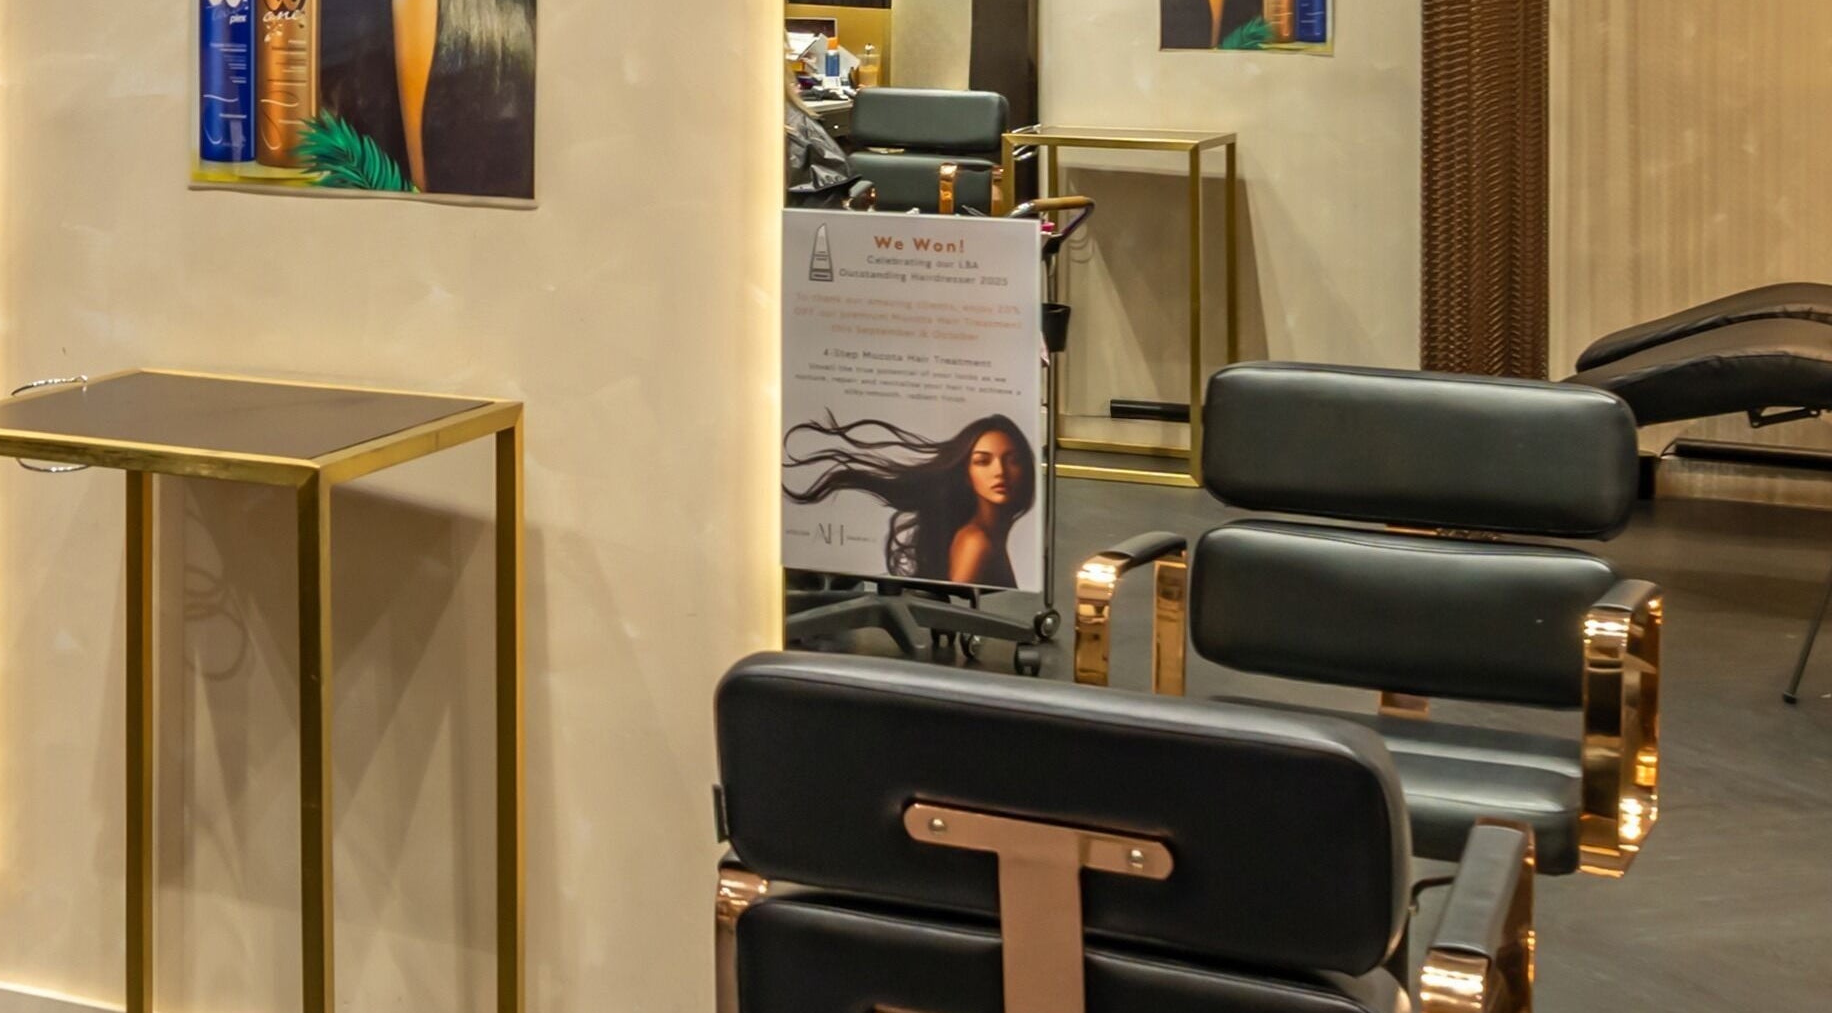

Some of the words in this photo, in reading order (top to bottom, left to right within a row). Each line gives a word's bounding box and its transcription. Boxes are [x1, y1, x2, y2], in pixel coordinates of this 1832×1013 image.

[874, 236, 904, 251] We
[913, 237, 966, 253] Won!
[866, 255, 931, 269] Celebrating
[936, 260, 954, 268] our
[839, 268, 906, 282] Outstanding
[911, 273, 976, 284] Hairdresser
[862, 350, 903, 362] Mucota
[907, 354, 929, 363] Hair
[933, 354, 992, 367] Treatment
